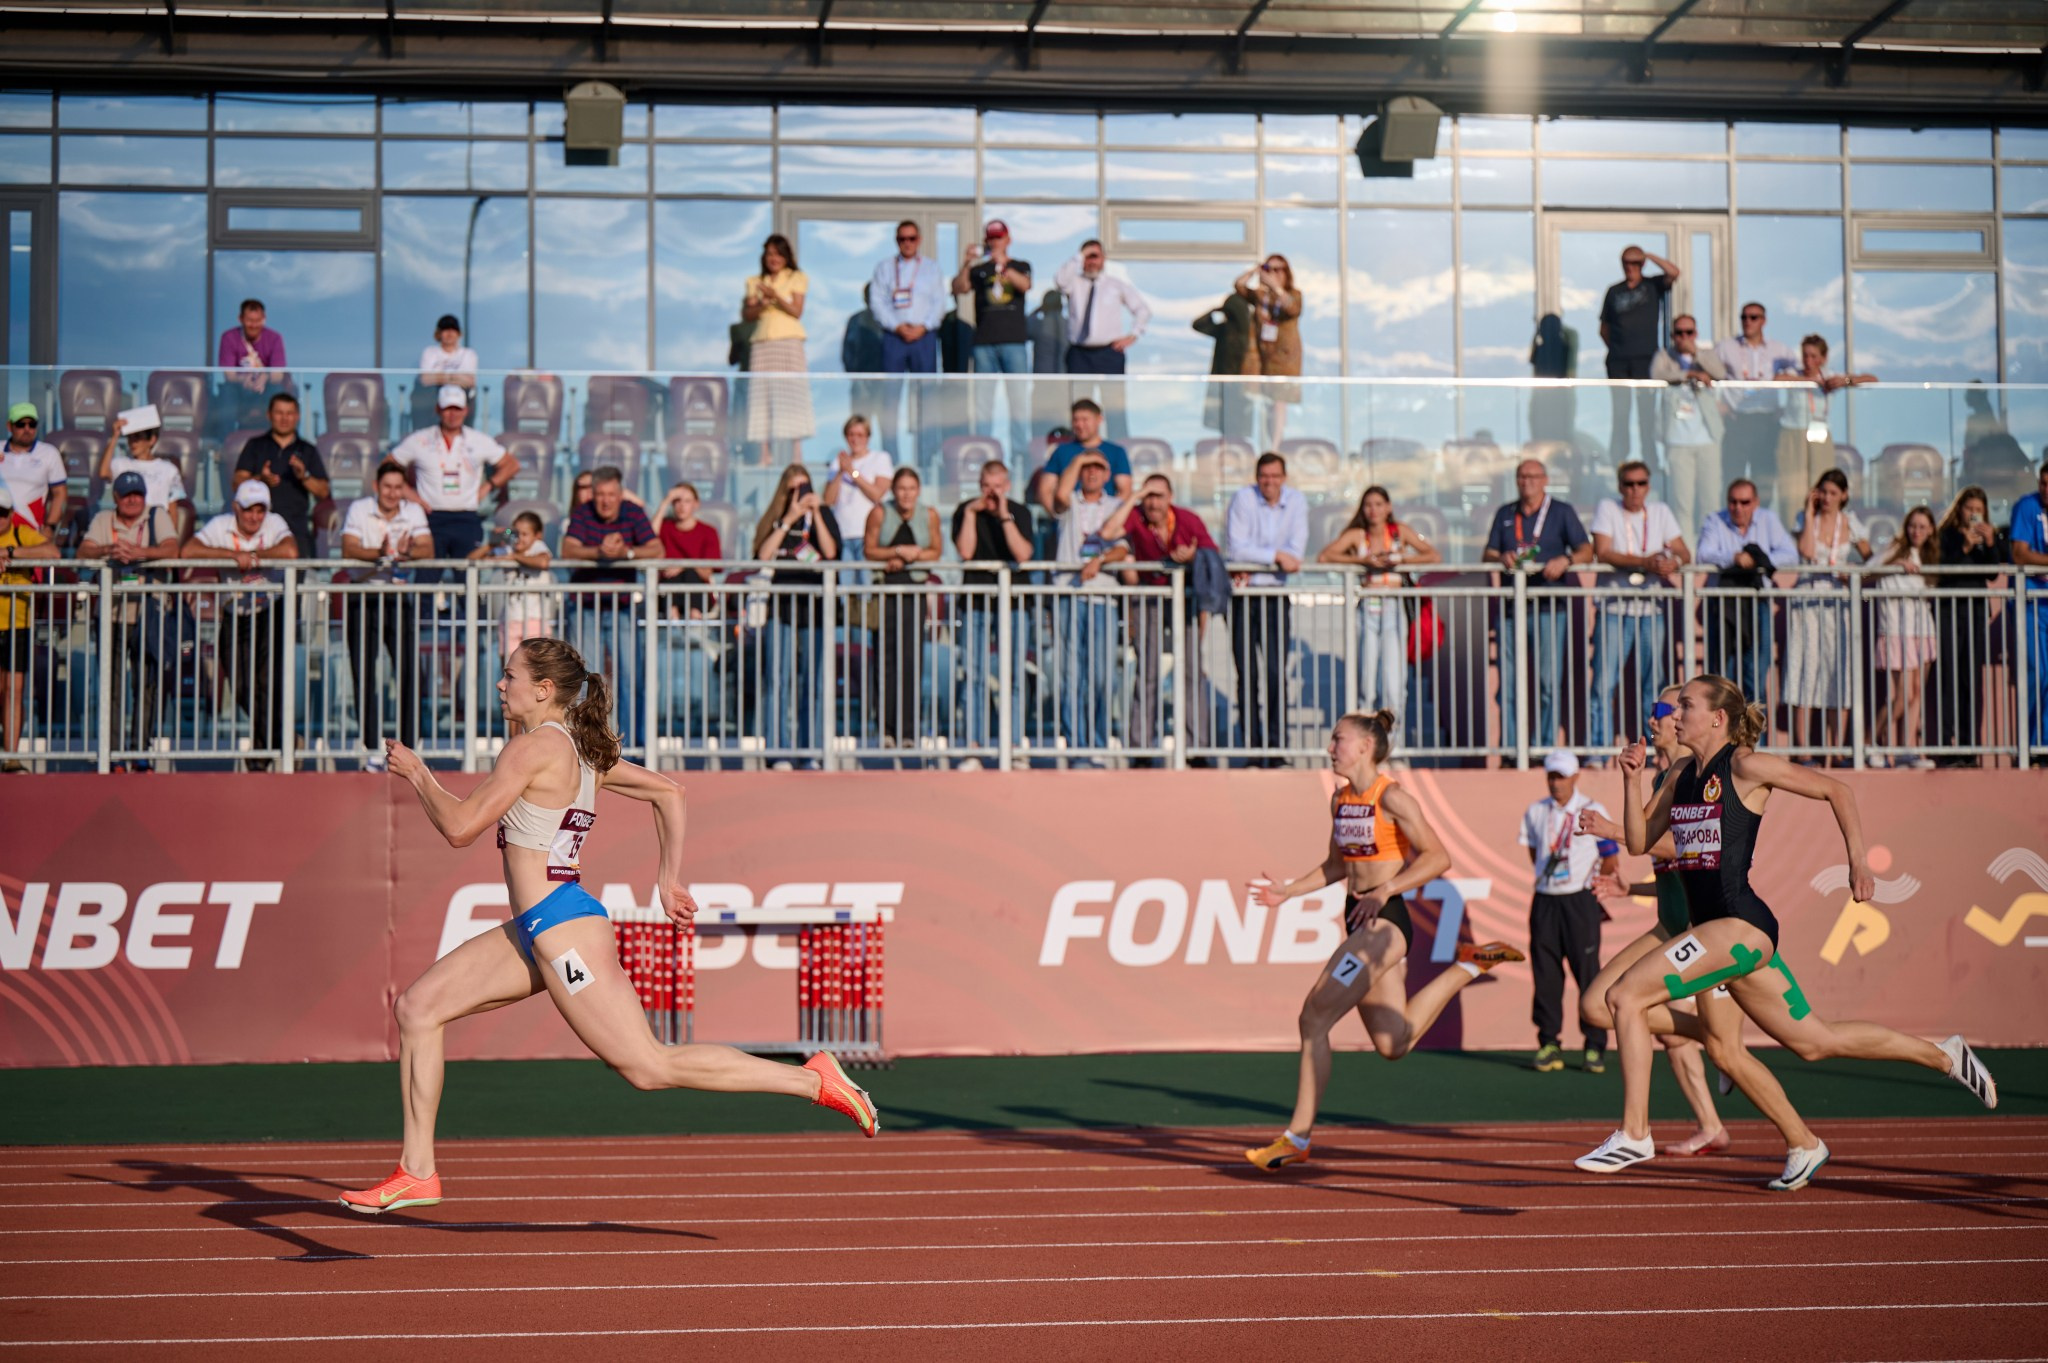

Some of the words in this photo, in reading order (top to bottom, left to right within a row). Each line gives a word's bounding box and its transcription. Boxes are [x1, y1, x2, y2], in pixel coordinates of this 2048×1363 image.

[1671, 805, 1715, 820] FONBET
[0, 881, 284, 970] NBET
[436, 882, 905, 970] FBET
[1038, 878, 1491, 967] FONBT
[1674, 941, 1698, 962] 5
[565, 960, 585, 985] 4
[1340, 959, 1358, 977] 7
